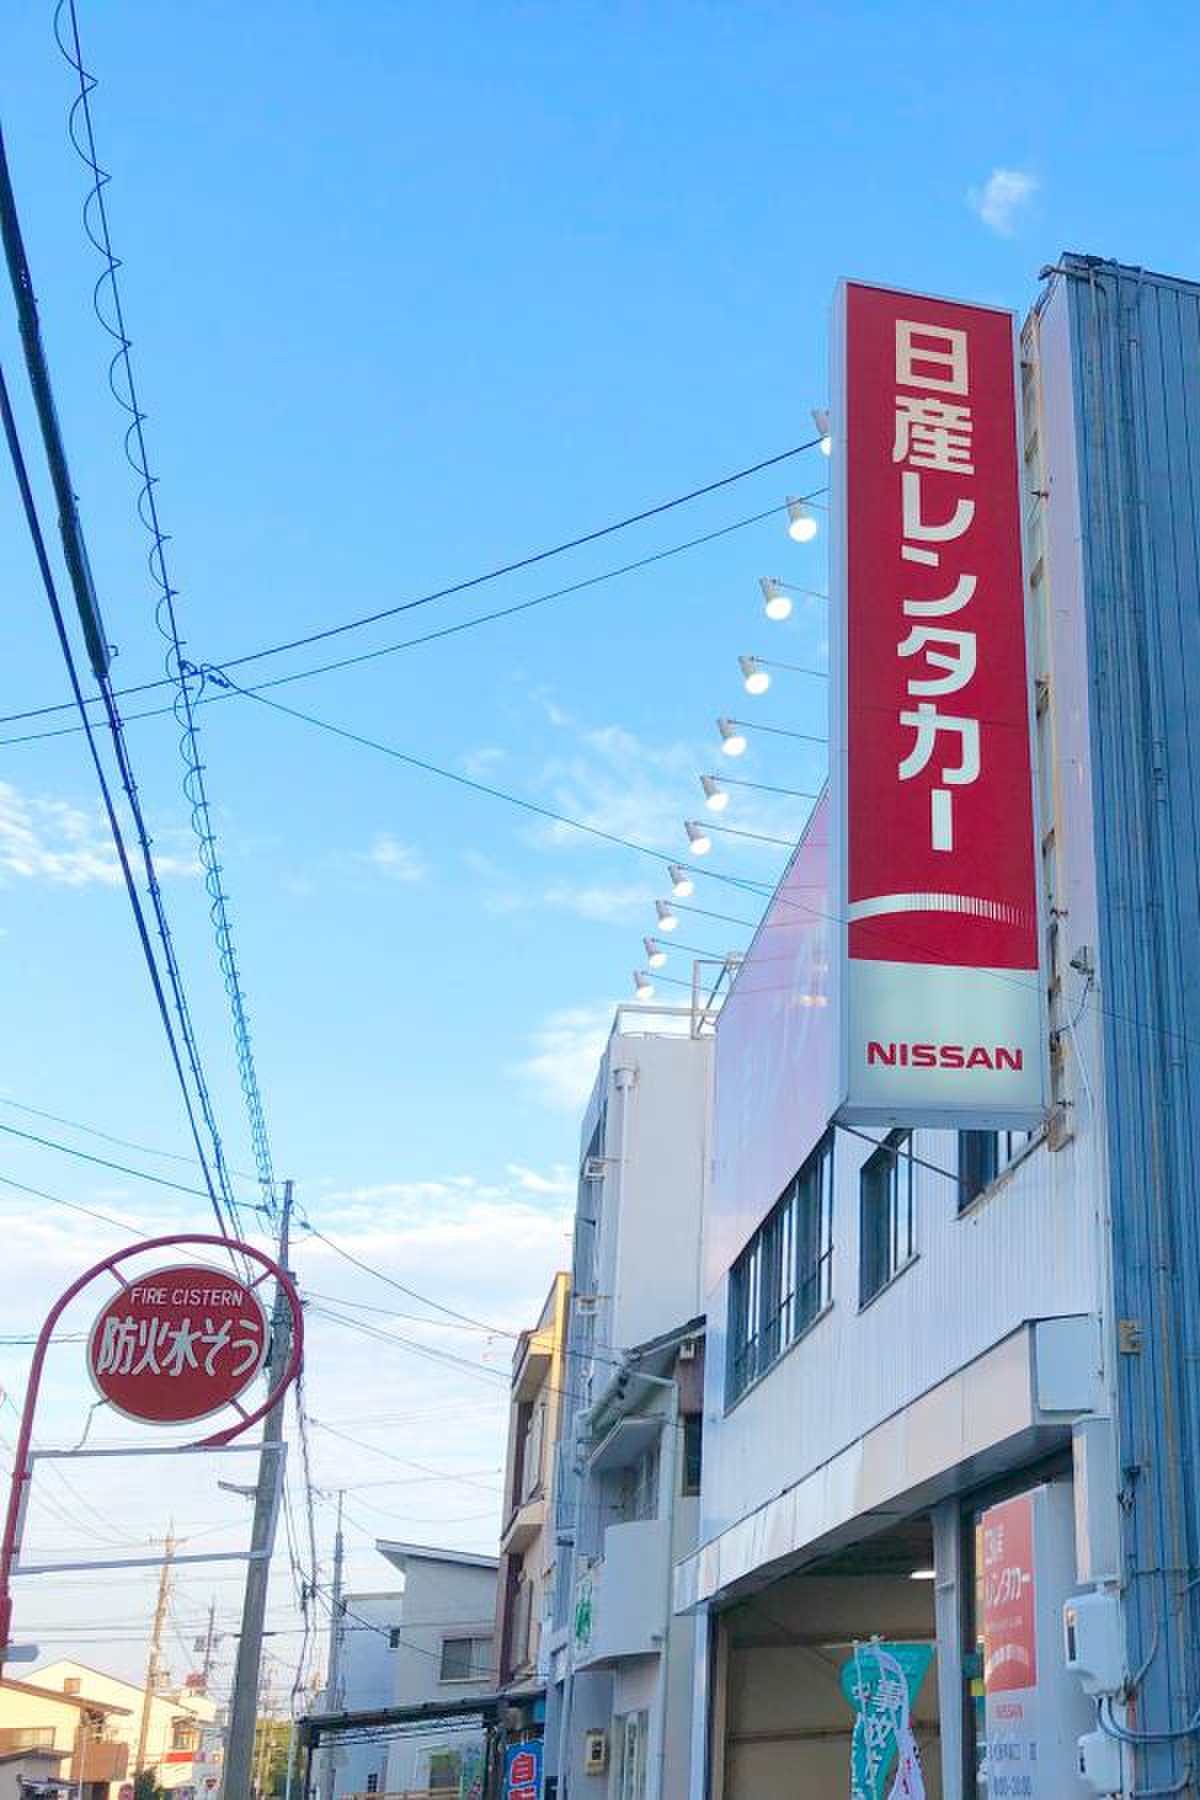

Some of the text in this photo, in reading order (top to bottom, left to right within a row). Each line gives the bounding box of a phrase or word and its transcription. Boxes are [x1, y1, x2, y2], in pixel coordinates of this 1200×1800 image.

[891, 318, 981, 853] 日産レンタカー
[866, 1041, 1024, 1072] NISSAN
[130, 1286, 244, 1307] FIRE CISTERN
[96, 1315, 259, 1377] 防火水そう
[508, 1752, 537, 1800] 自
